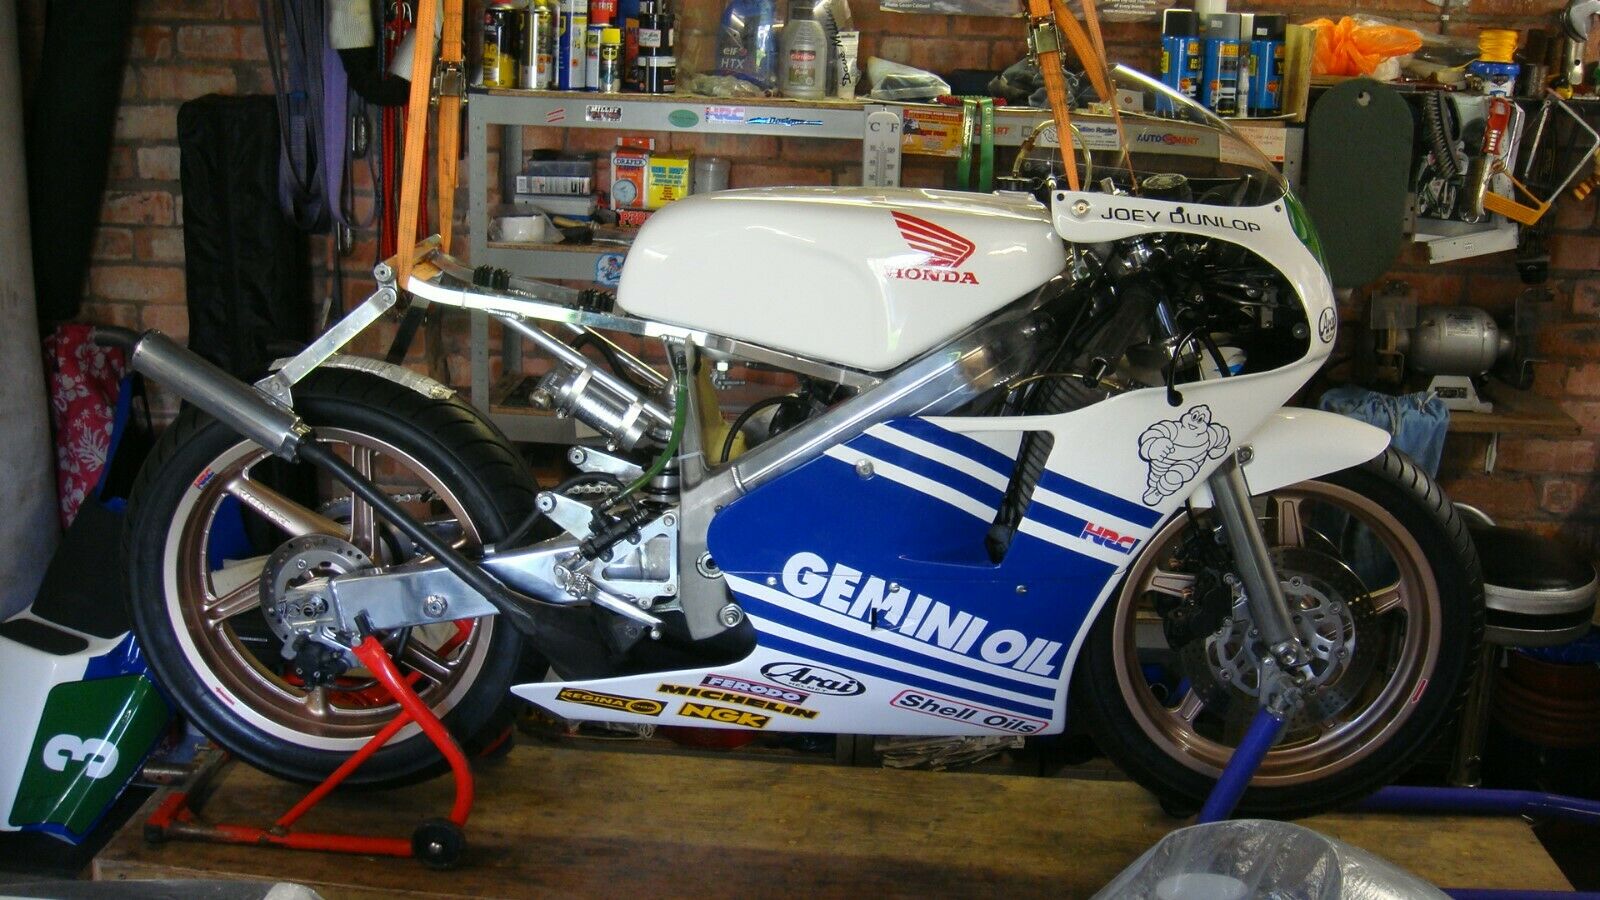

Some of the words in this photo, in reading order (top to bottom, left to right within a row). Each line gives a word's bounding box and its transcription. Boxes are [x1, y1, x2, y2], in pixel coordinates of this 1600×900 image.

[721, 57, 744, 69] HTX
[1100, 207, 1161, 223] JOEY
[1169, 210, 1261, 233] DUNLOP
[1080, 521, 1138, 555] HRC
[782, 551, 989, 655] GEMINI
[980, 629, 1063, 676] OIL
[708, 677, 801, 701] FERODO
[765, 667, 857, 693] Arai
[560, 690, 624, 707] REGINA
[658, 684, 820, 718] MICHELIN
[681, 702, 767, 728] NGK
[900, 694, 979, 720] Shell
[983, 714, 1037, 733] Oils
[43, 733, 120, 779] 3
